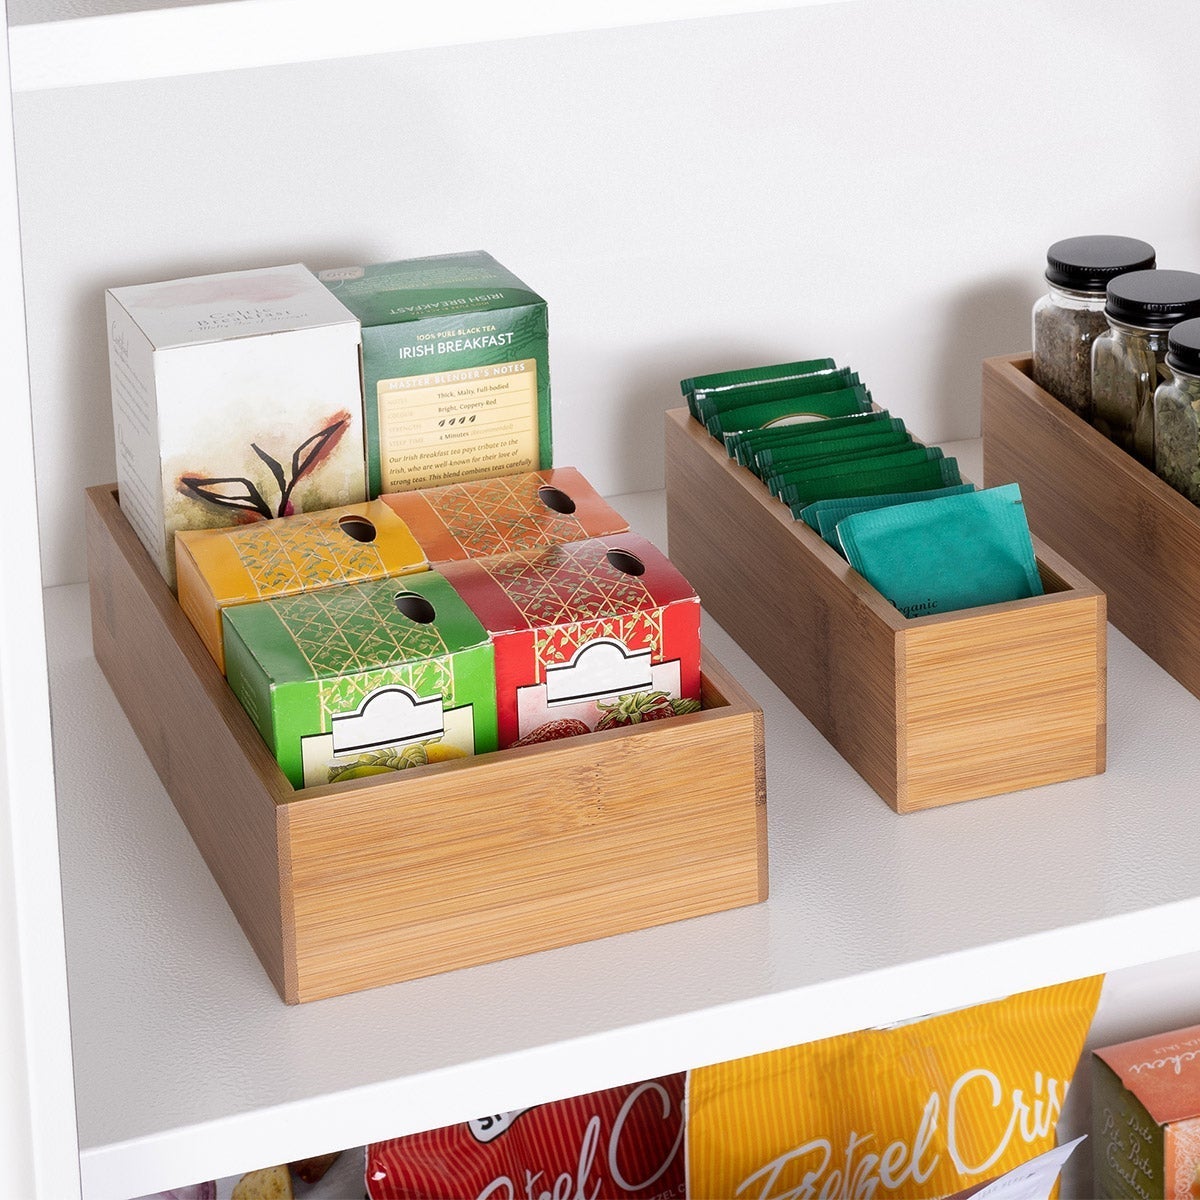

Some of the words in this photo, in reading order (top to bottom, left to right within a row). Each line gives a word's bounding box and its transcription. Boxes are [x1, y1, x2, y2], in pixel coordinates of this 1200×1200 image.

[399, 344, 435, 360] IRISH
[438, 331, 515, 354] BREAKFAST
[416, 330, 436, 342] 100%
[437, 329, 456, 339] PURE
[457, 327, 481, 337] BLACK
[482, 325, 497, 333] TEA
[389, 378, 430, 390] MASTER
[493, 362, 526, 375] NOTES
[438, 406, 458, 415] Bright,
[459, 401, 485, 412] Coppery
[486, 399, 497, 407] Red
[389, 456, 402, 464] Our
[402, 453, 418, 462] Irish
[419, 449, 450, 460] Breakfast
[451, 448, 461, 456] tea
[462, 445, 477, 456] pays
[477, 442, 499, 452] tribute
[508, 438, 519, 447] the
[389, 467, 406, 477] Irish,
[407, 464, 422, 473] who
[423, 463, 433, 471] are
[434, 457, 471, 470] well-known
[471, 456, 482, 466] for
[482, 453, 497, 462] their
[498, 451, 511, 460] love
[511, 448, 519, 458] of
[390, 478, 412, 488] strong
[412, 475, 427, 484] teas.
[429, 473, 442, 481] This
[443, 469, 461, 479] blend
[461, 465, 491, 476] combines
[491, 462, 505, 471] teas
[505, 457, 533, 469] carefully
[948, 1067, 1070, 1175] Cris
